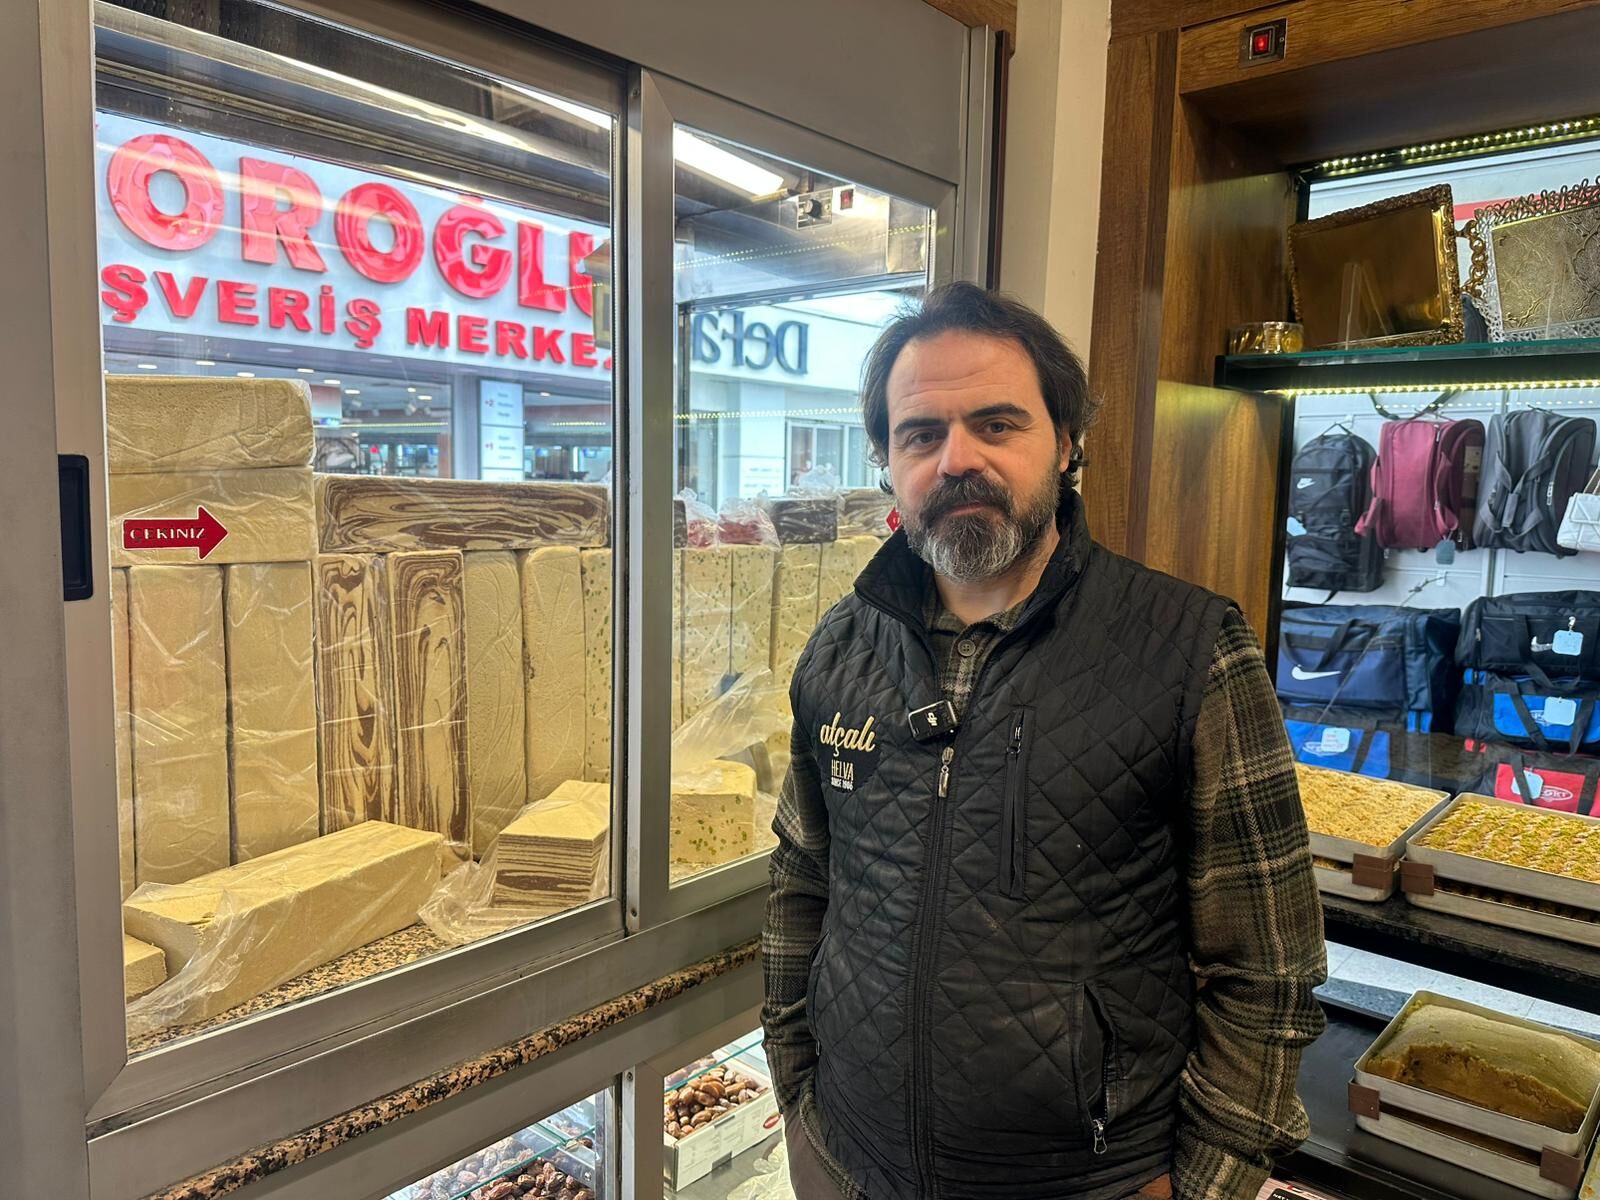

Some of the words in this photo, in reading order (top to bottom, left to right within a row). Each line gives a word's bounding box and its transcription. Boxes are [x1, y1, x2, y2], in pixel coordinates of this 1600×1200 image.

[101, 264, 382, 348] ŞVERİŞ
[406, 307, 612, 369] MERKE
[831, 759, 853, 781] HELVA
